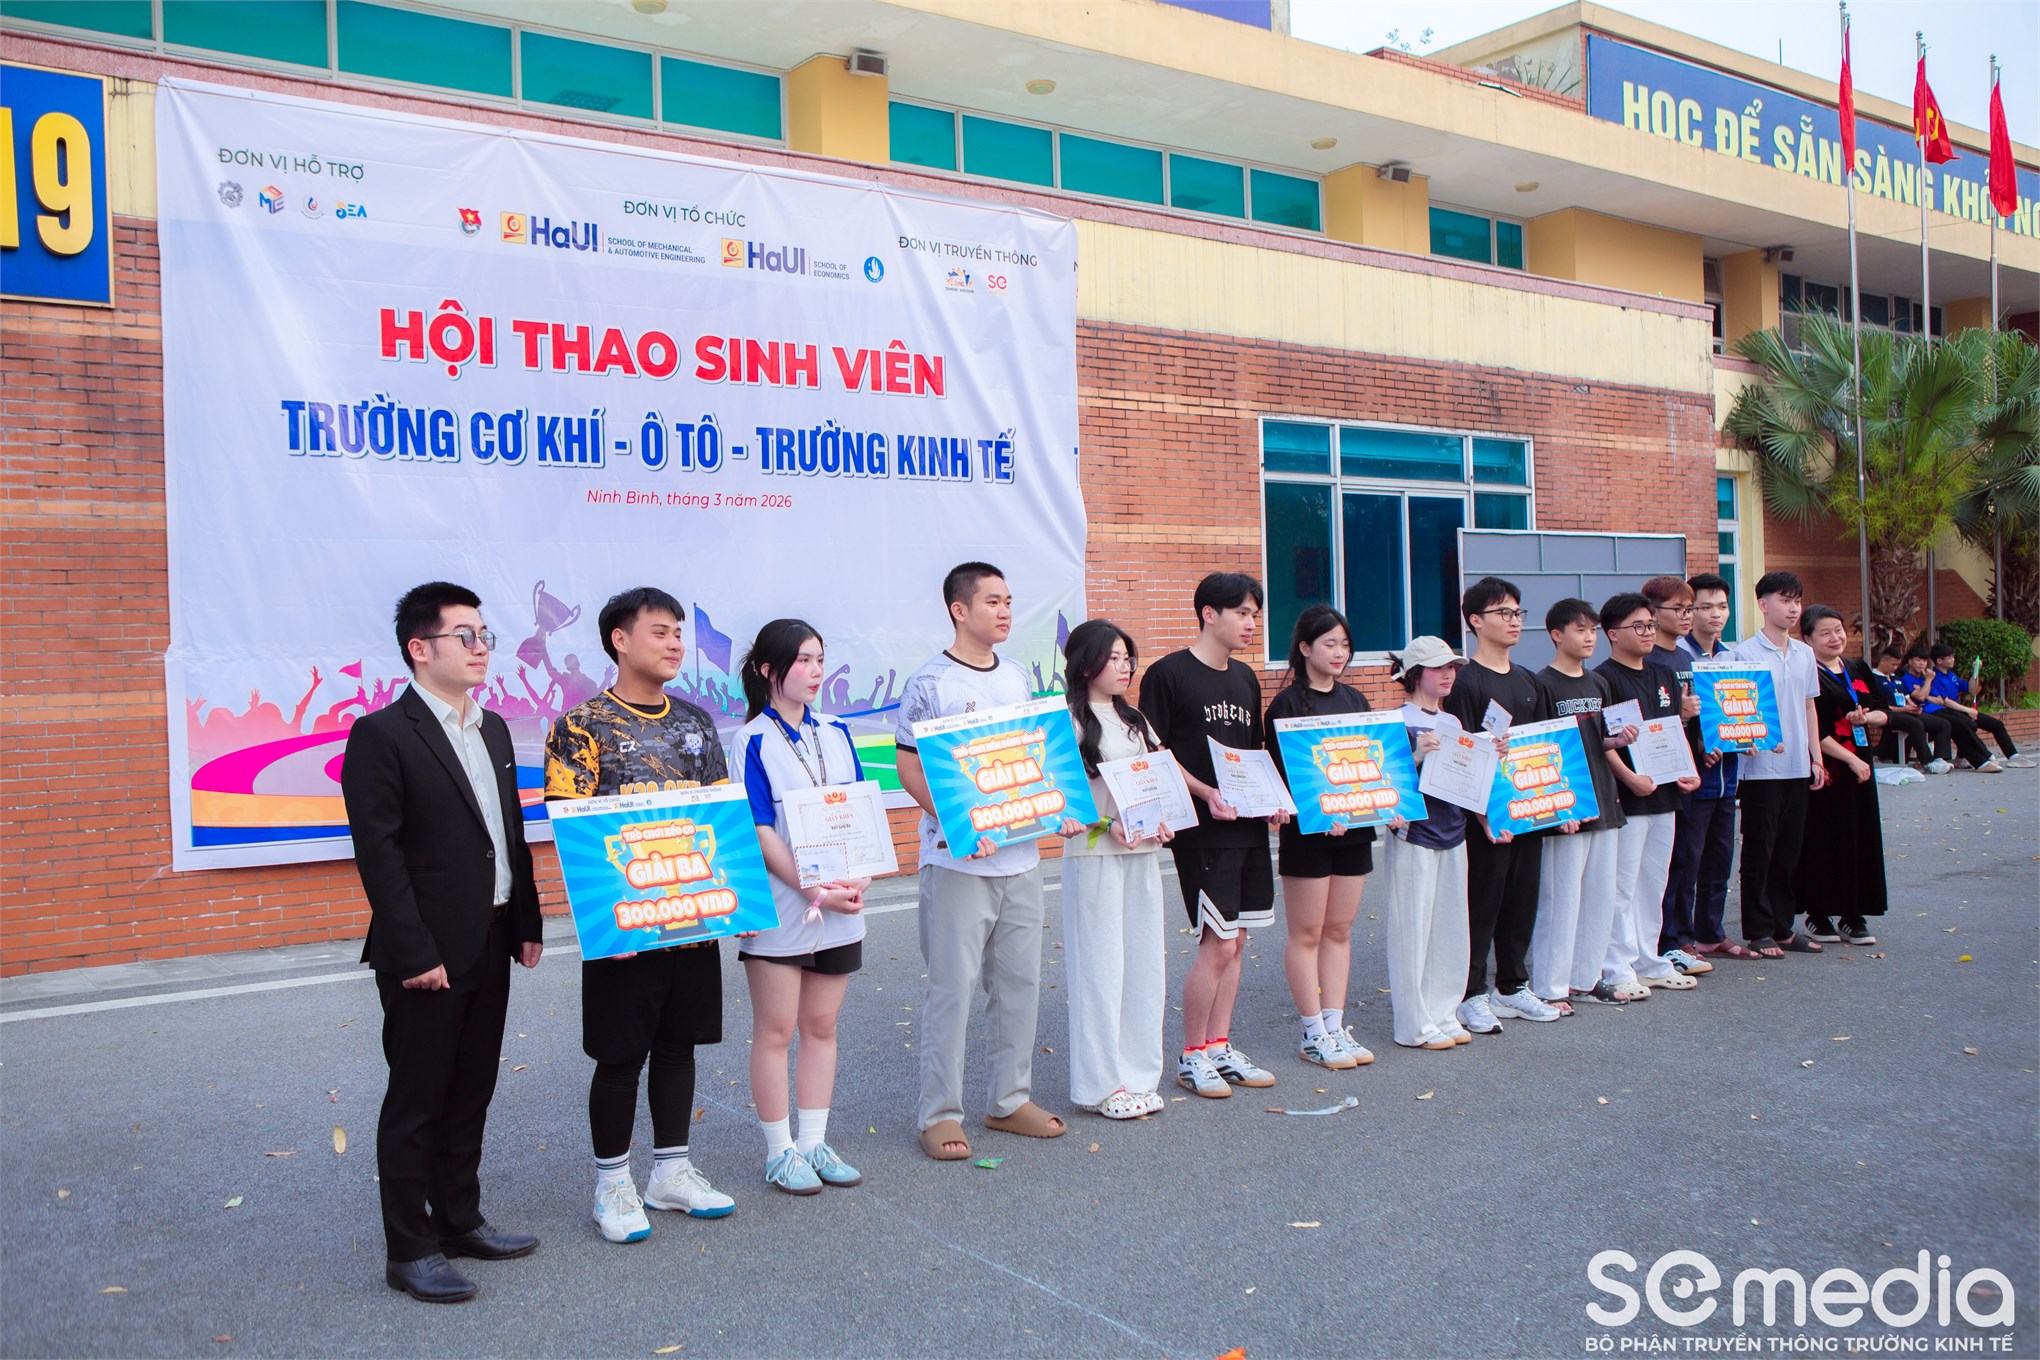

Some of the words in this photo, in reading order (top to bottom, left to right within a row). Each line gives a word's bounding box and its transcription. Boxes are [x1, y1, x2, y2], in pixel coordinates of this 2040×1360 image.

[1714, 98, 1762, 164] ĐỂ
[1773, 115, 1841, 186] SẴN
[1853, 144, 1934, 208] SÀNG
[218, 148, 264, 168] ĐƠN
[269, 154, 287, 174] VỊ
[294, 154, 322, 174] HỖ
[327, 162, 364, 183] TRỢ
[623, 200, 658, 217] ĐƠN
[662, 206, 677, 223] VỊ
[683, 204, 701, 223] TỔ
[704, 210, 746, 228] CHỨC
[607, 237, 636, 249] SCHOOL
[638, 240, 647, 249] OF
[648, 241, 693, 254] MECHANICAL
[614, 248, 660, 260] AUTOMOTIVE
[661, 252, 706, 264] ENGINEERING
[898, 236, 926, 252] ĐƠN
[929, 241, 941, 257] VỊ
[944, 244, 992, 261] TRUYỀN
[995, 250, 1038, 267] THÔNG
[813, 261, 838, 270] SCHOOL
[813, 271, 850, 280] ECONOMICS
[380, 299, 494, 378] HỘI
[512, 319, 680, 379] THAO
[695, 335, 820, 388] SINH
[832, 339, 947, 398] VIÊN
[281, 391, 459, 462] TRƯỜNG
[470, 408, 528, 465] CƠ
[536, 408, 605, 467] KHÍ
[641, 411, 667, 472] Ô
[675, 413, 722, 472] TÔ
[755, 418, 888, 478] TRƯỜNG
[896, 434, 971, 481] KINH
[977, 428, 1016, 483] TẾ
[587, 489, 621, 504] Ninh
[626, 491, 662, 507] Bình,
[667, 492, 710, 509] tháng
[713, 494, 722, 507] 3
[725, 493, 757, 507] năm
[761, 494, 792, 508] 2026
[1723, 697, 1742, 714] GIẢI
[1742, 698, 1756, 714] BA
[1719, 725, 1751, 739] 300.000
[978, 762, 1014, 789] GIẢI
[1014, 761, 1039, 782] BA
[1328, 759, 1358, 783] GIẢI
[1358, 761, 1380, 779] BA
[1514, 766, 1540, 789] GIẢI
[1540, 765, 1558, 784] BA
[1323, 793, 1373, 811] 300.000
[1510, 799, 1551, 818] 300.000
[972, 801, 1033, 828] 300.000
[629, 854, 675, 885] GIẢI
[675, 855, 707, 880] BA
[618, 901, 697, 926] 300.000
